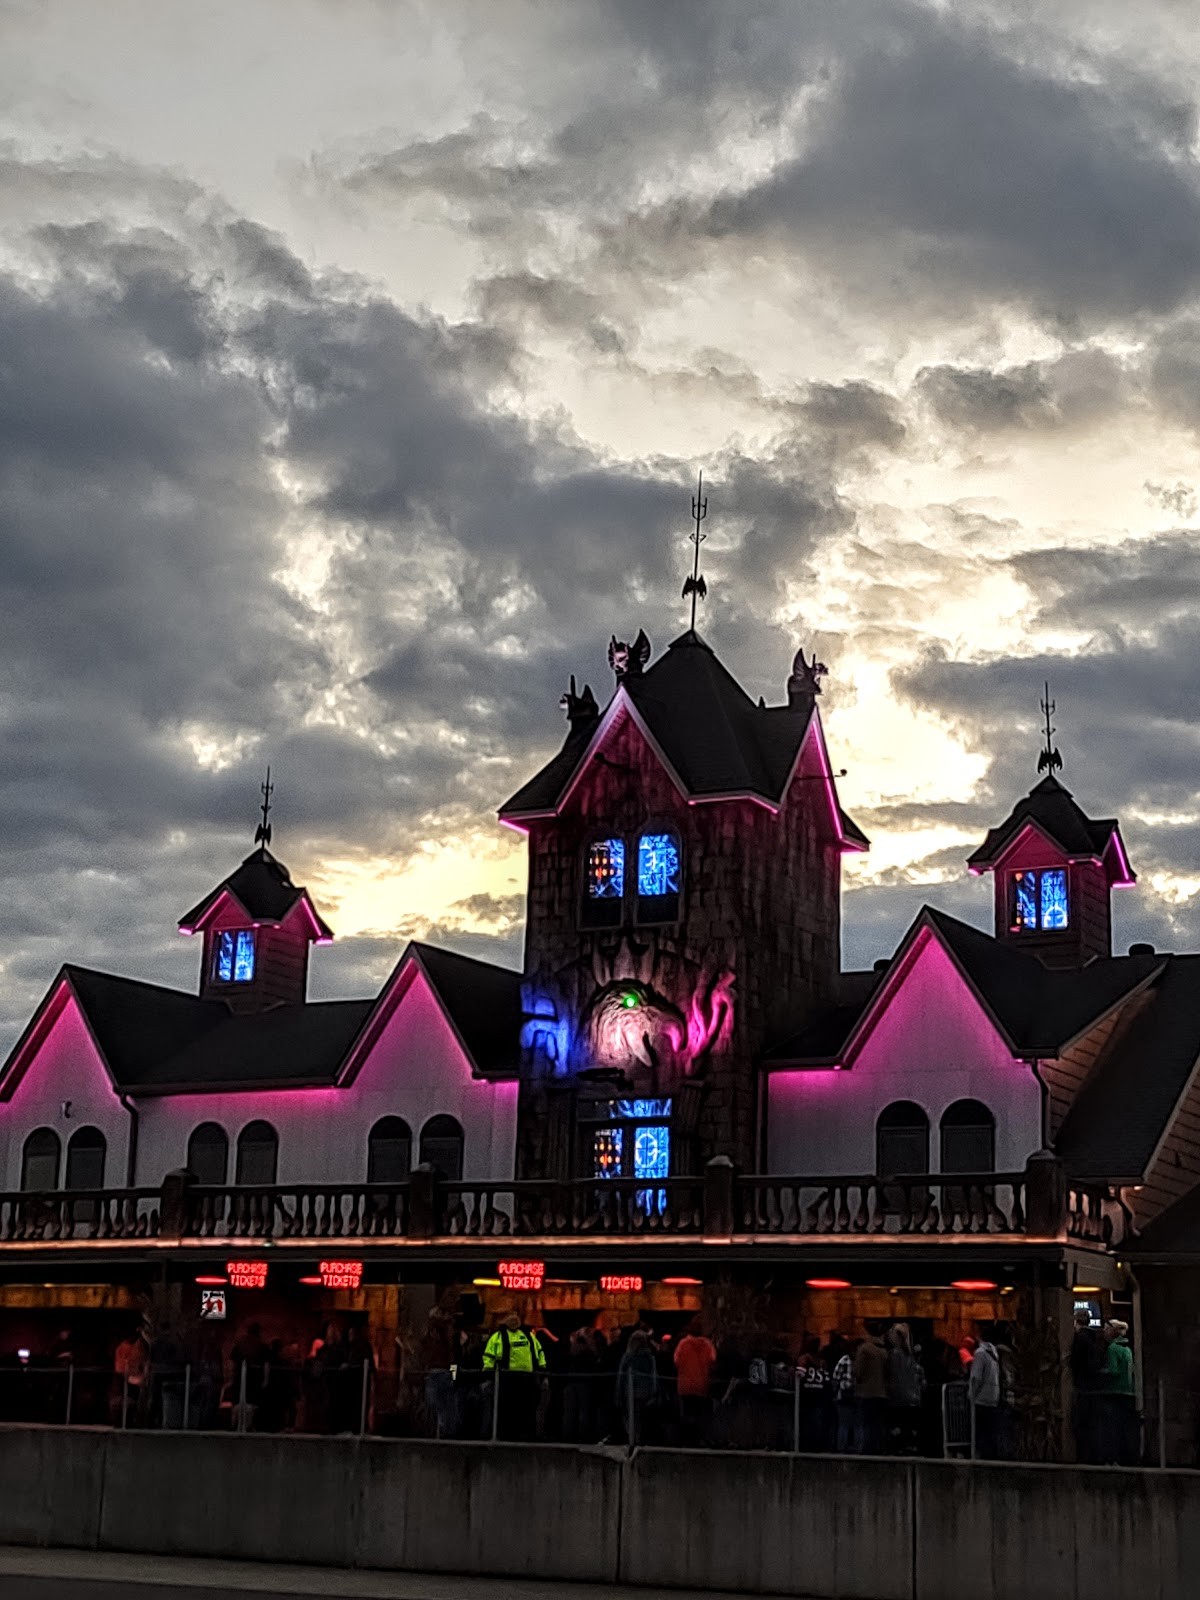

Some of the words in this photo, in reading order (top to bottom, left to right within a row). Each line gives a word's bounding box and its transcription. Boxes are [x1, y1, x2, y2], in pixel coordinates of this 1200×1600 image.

[227, 1263, 268, 1275] PURCHASE
[320, 1262, 362, 1275] PURCHASE
[499, 1263, 544, 1275] PURCHASE
[230, 1275, 266, 1288] TICKETS
[322, 1275, 360, 1288] TICKETS
[502, 1276, 541, 1289] TICKETS
[600, 1277, 642, 1290] TICKETS
